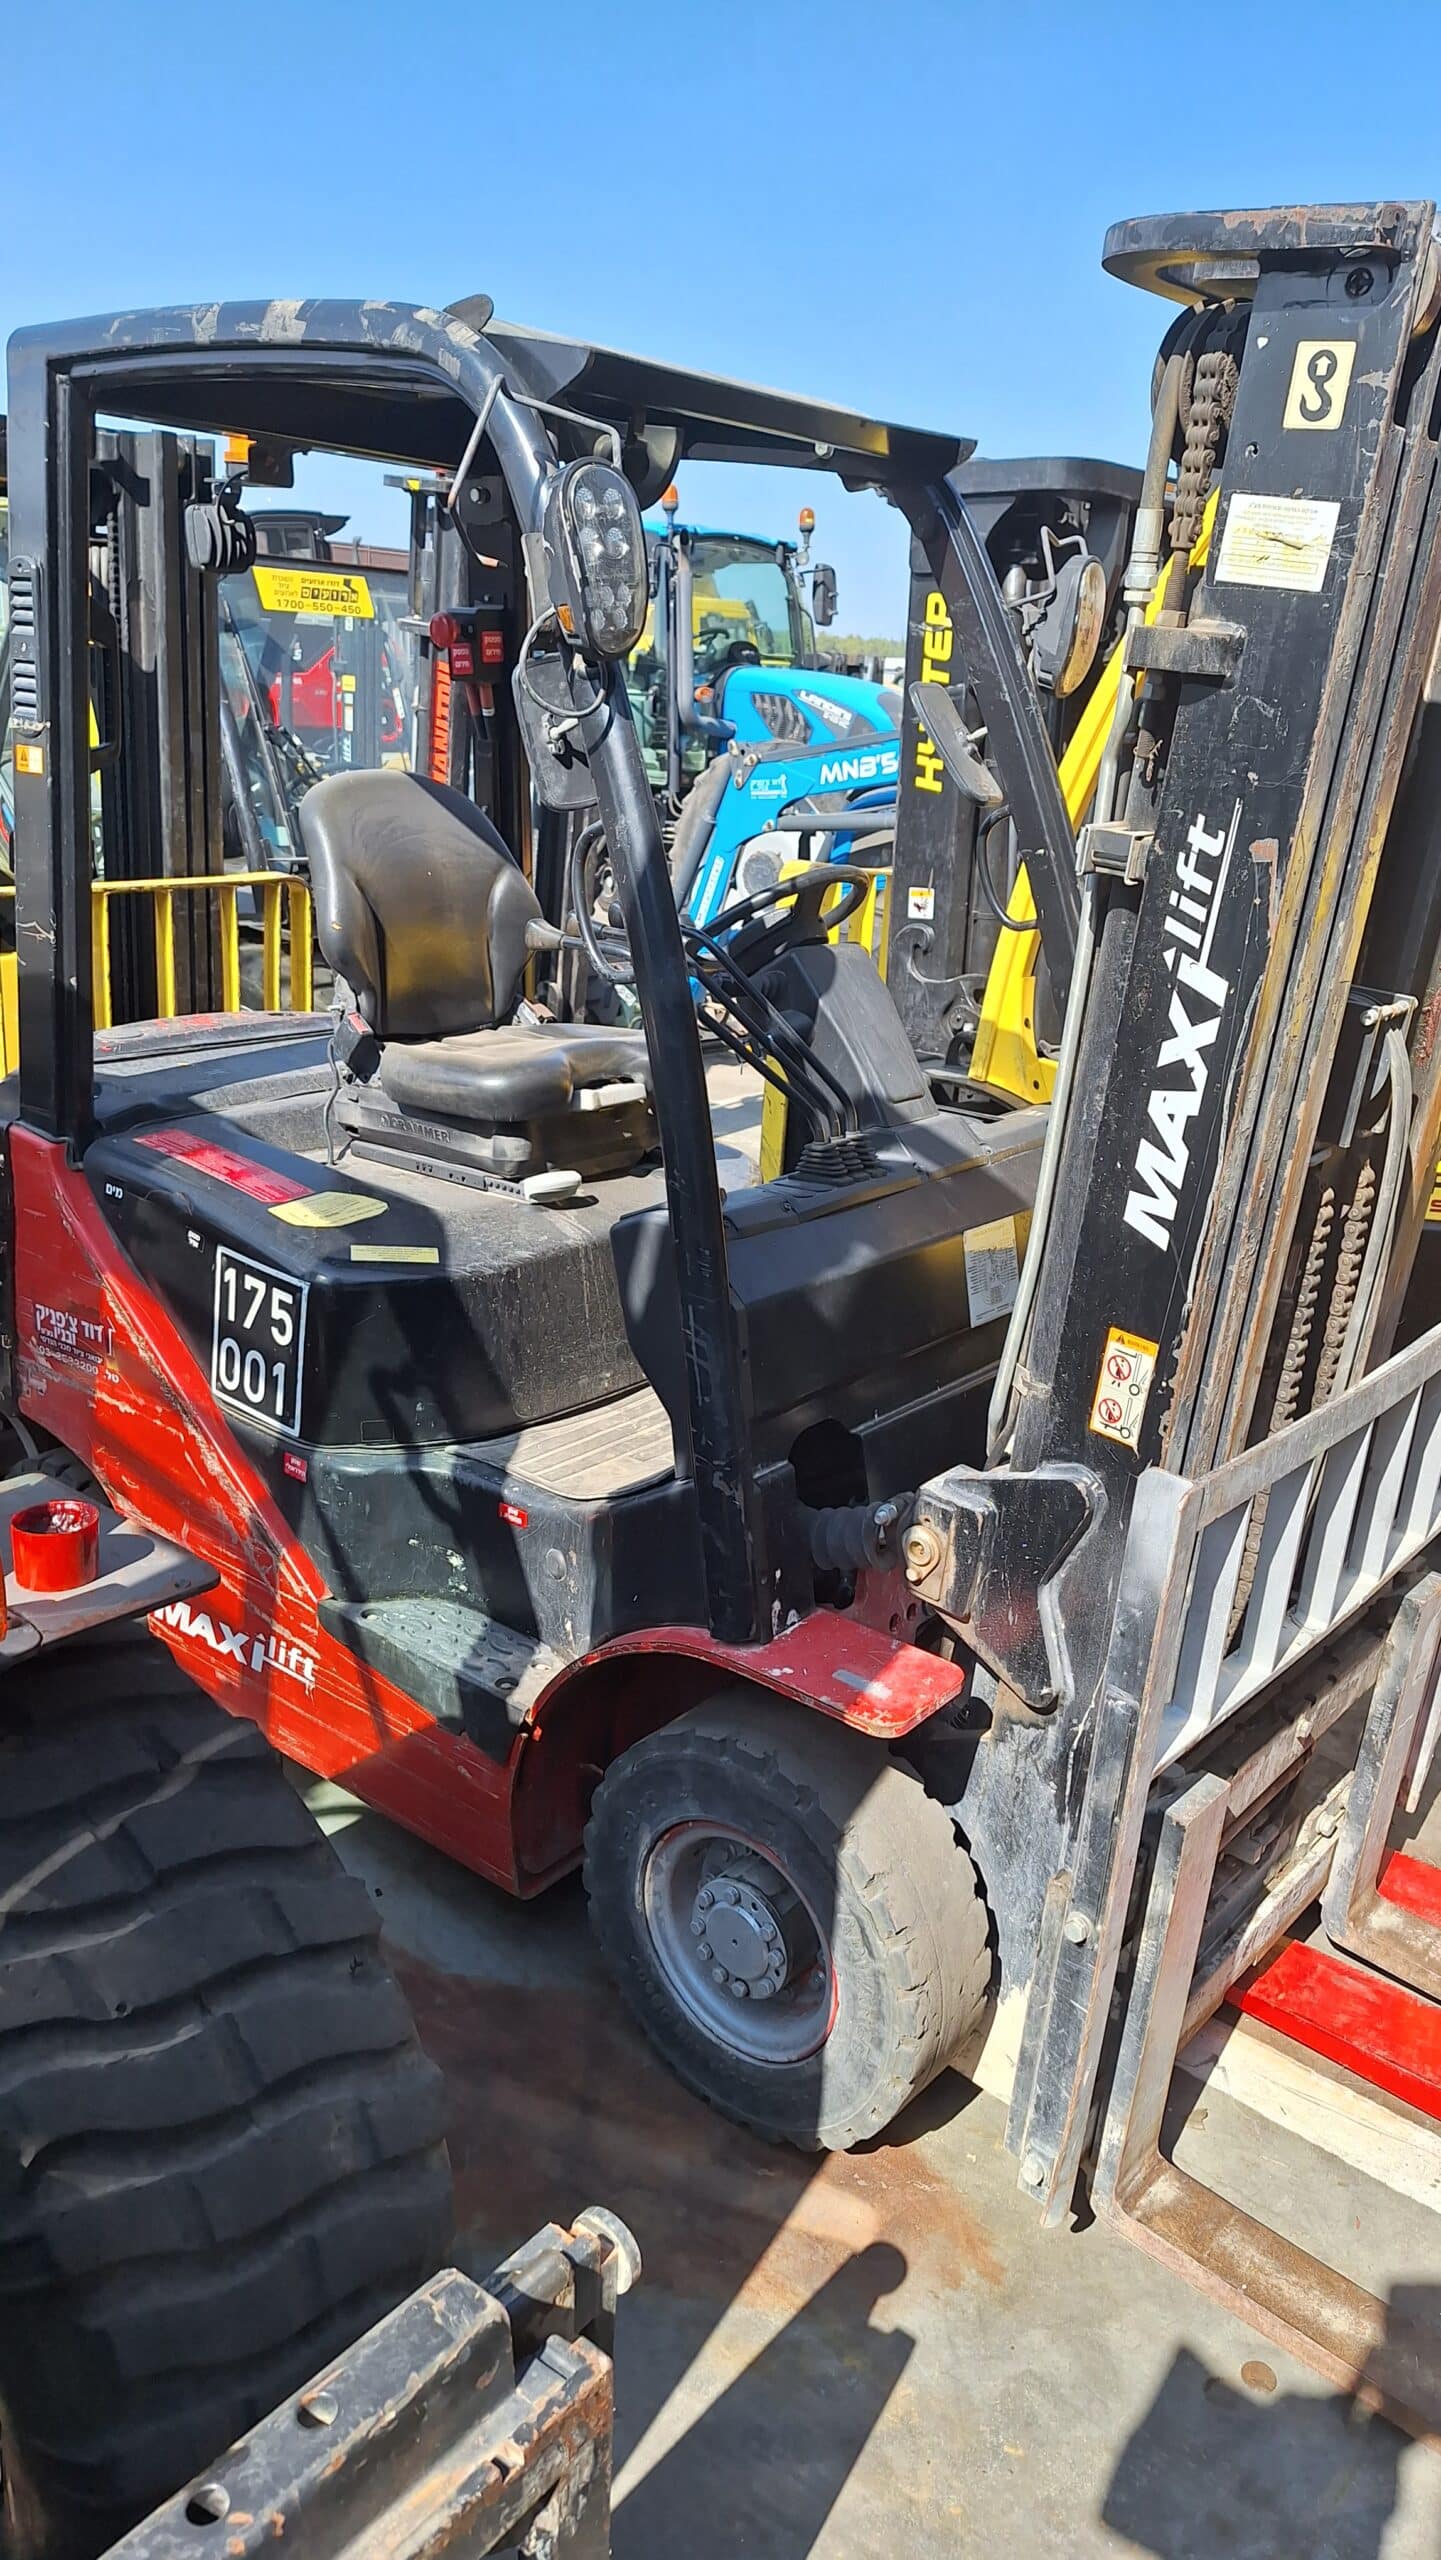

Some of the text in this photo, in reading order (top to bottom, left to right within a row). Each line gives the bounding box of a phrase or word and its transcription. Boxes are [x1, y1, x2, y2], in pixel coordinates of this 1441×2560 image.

[105, 1183, 124, 1199] מים
[80, 1320, 104, 1343] דוד
[223, 1267, 294, 1346] 175
[219, 1337, 286, 1416] 001
